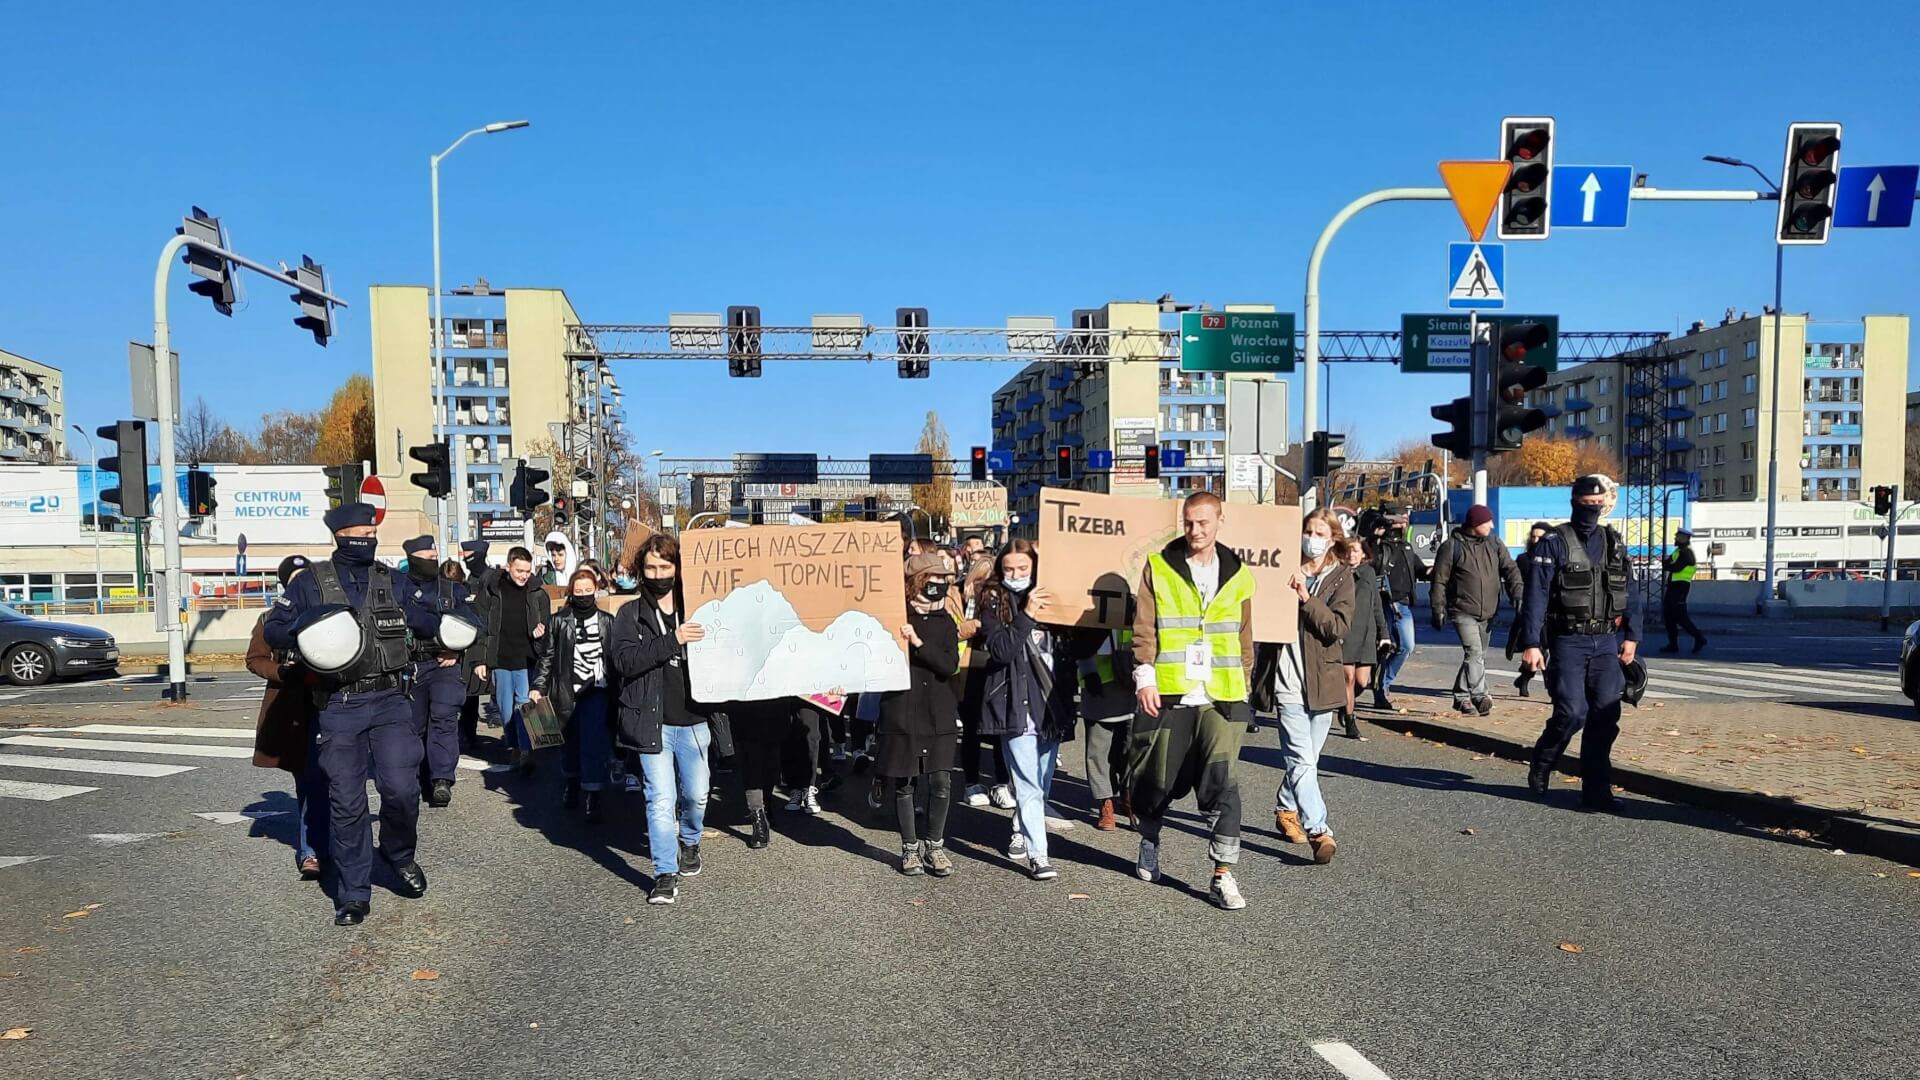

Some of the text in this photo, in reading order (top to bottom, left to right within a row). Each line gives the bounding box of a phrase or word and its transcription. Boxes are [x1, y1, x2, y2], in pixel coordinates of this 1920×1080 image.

[1207, 316, 1279, 328] 79 Poznań
[1427, 318, 1471, 331] Siemia
[1230, 334, 1288, 346] Wrocław
[1429, 337, 1469, 347] Koszutk
[1230, 351, 1280, 364] Gliwice
[234, 491, 301, 502] CENTRUM
[30, 495, 59, 512] 20
[235, 506, 310, 517] MEDYCZNE
[1716, 529, 1749, 537] KURSY
[1763, 528, 1793, 537] TŃCA
[694, 531, 898, 566] NIECH NASZ ZAPAŁ
[1231, 547, 1282, 568] AŁAĆ
[774, 560, 883, 602] TOPNIEJE
[377, 618, 405, 627] POLICJA
